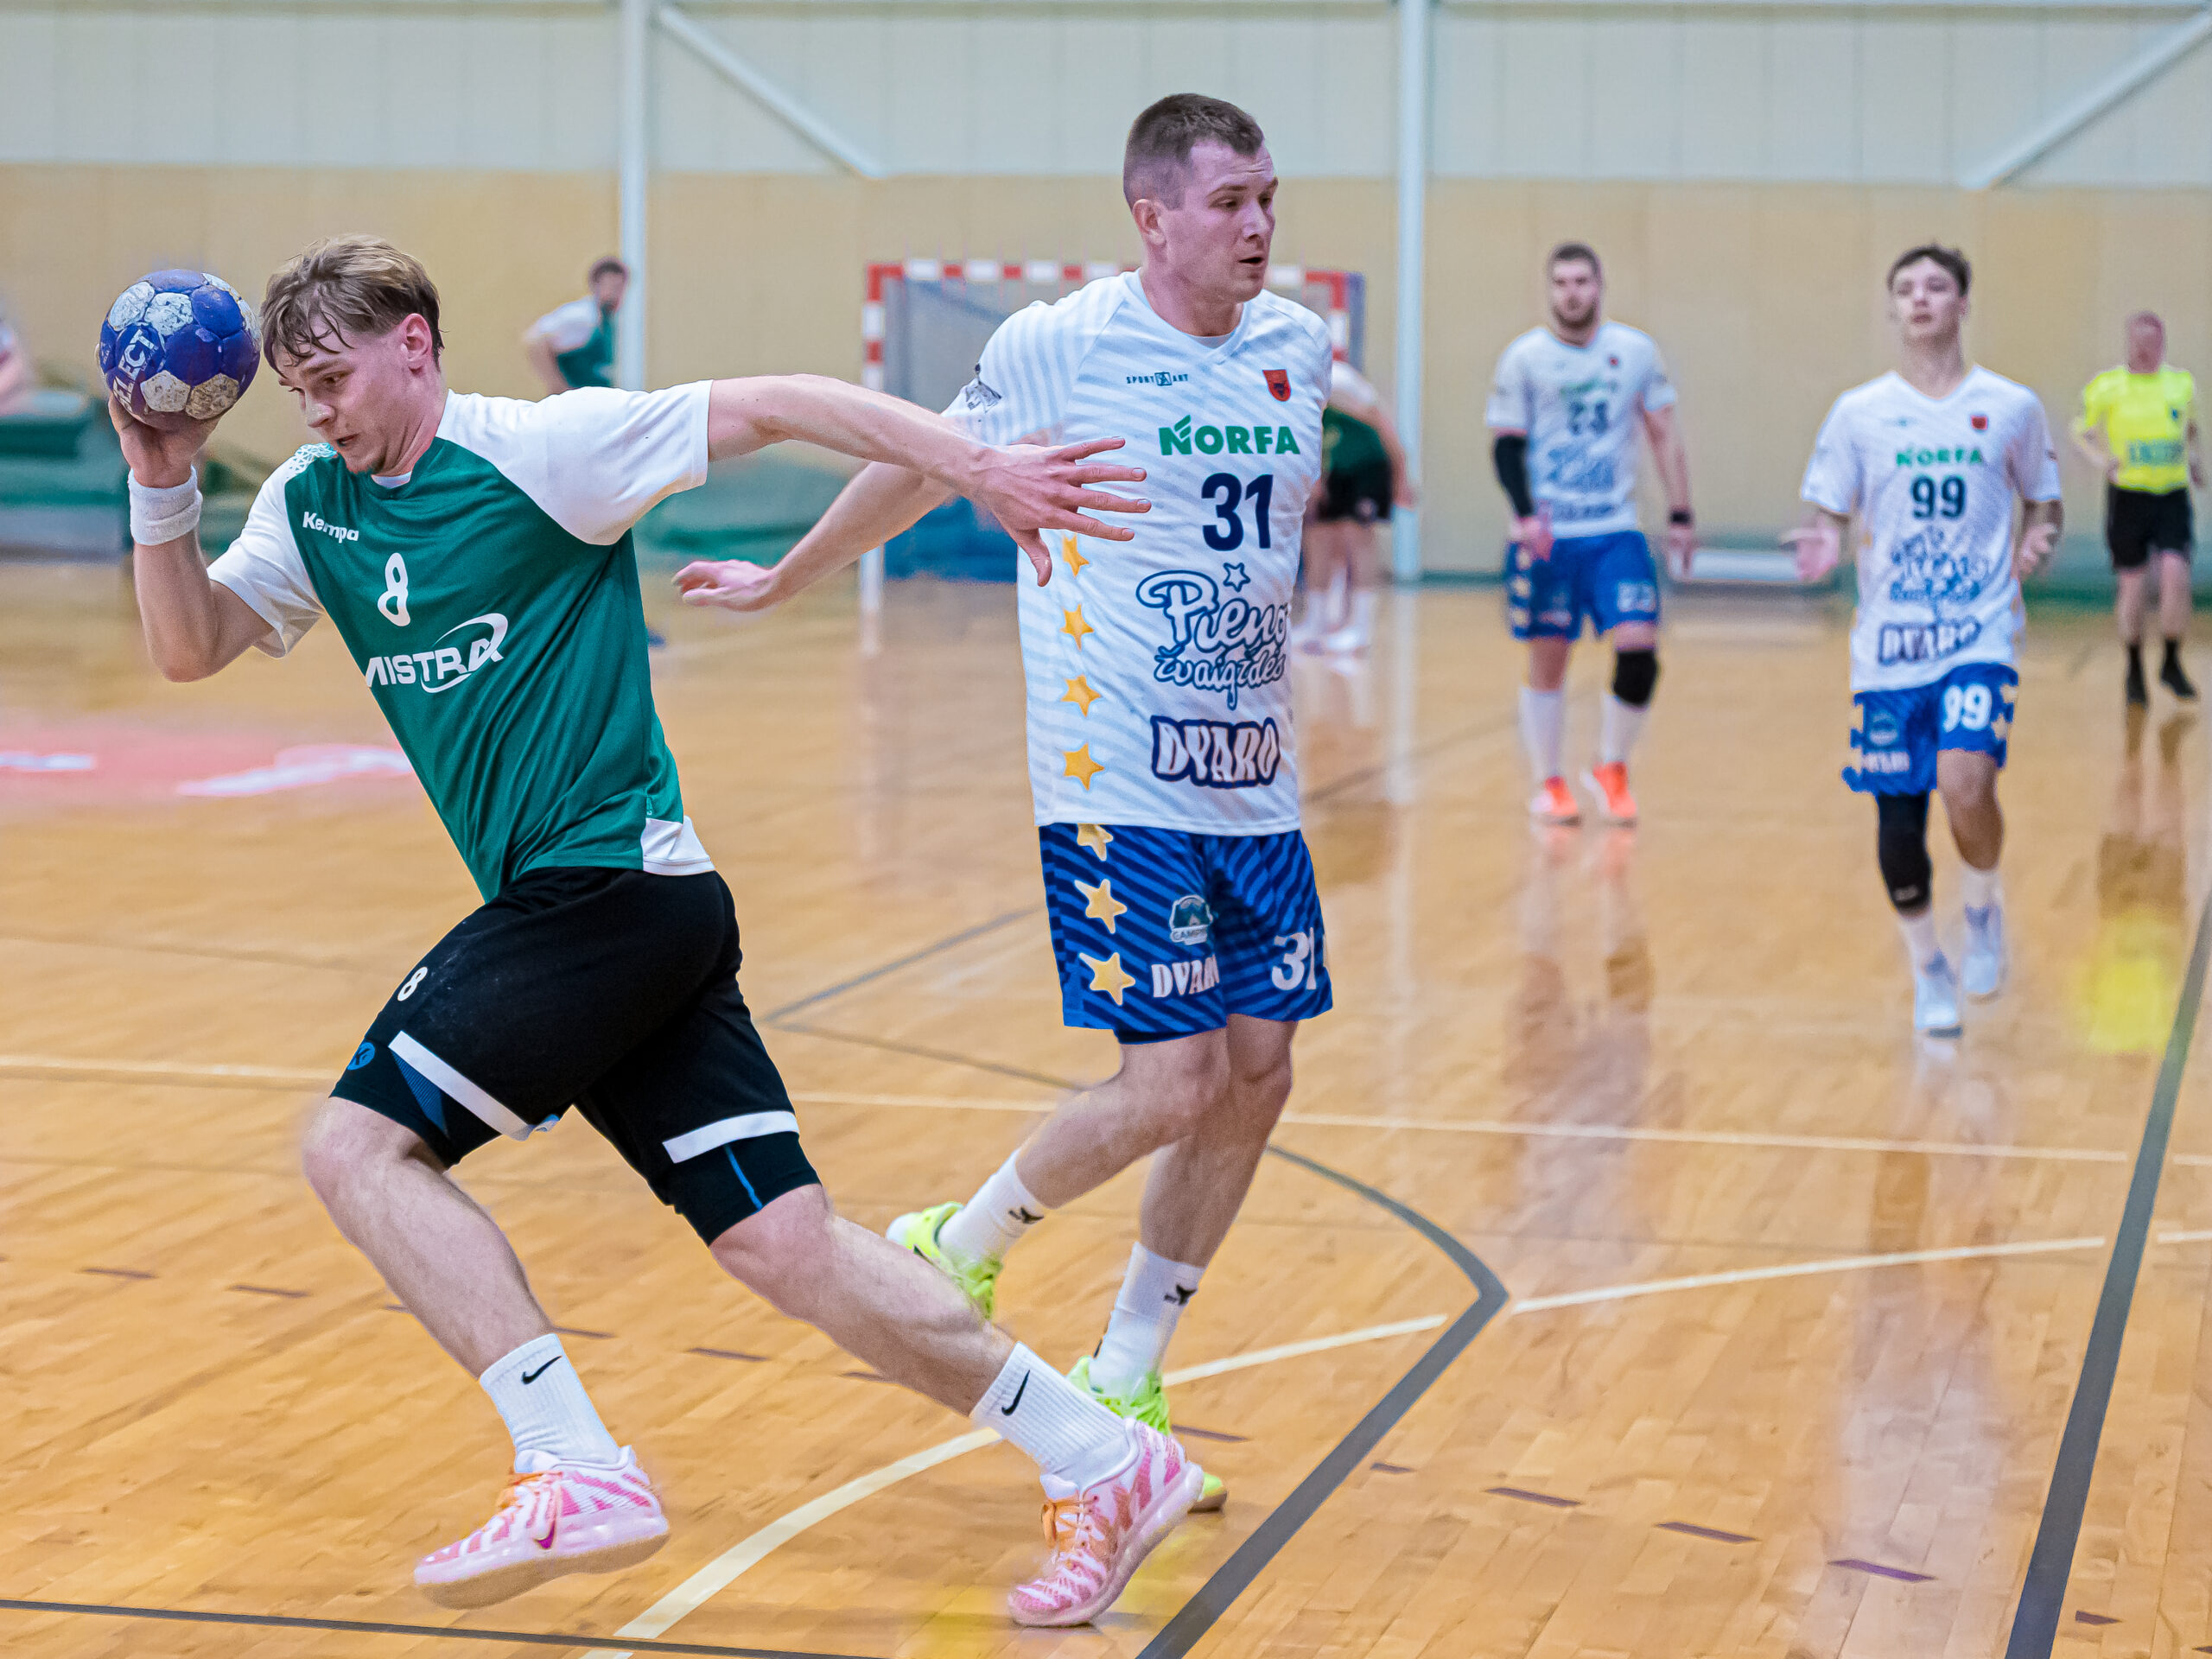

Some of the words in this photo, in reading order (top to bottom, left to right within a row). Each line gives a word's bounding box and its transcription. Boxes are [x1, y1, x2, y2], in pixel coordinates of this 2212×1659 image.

[1126, 375, 1154, 385] SPORT
[1173, 373, 1189, 382] ART
[1159, 415, 1300, 455] NORFA
[1202, 473, 1274, 551] 31
[1910, 475, 1967, 518] 99
[303, 512, 359, 543] Kempa
[377, 552, 411, 627] 8
[1135, 570, 1289, 653] Pieno
[1150, 715, 1281, 790] DYARO
[397, 966, 429, 1001] 8
